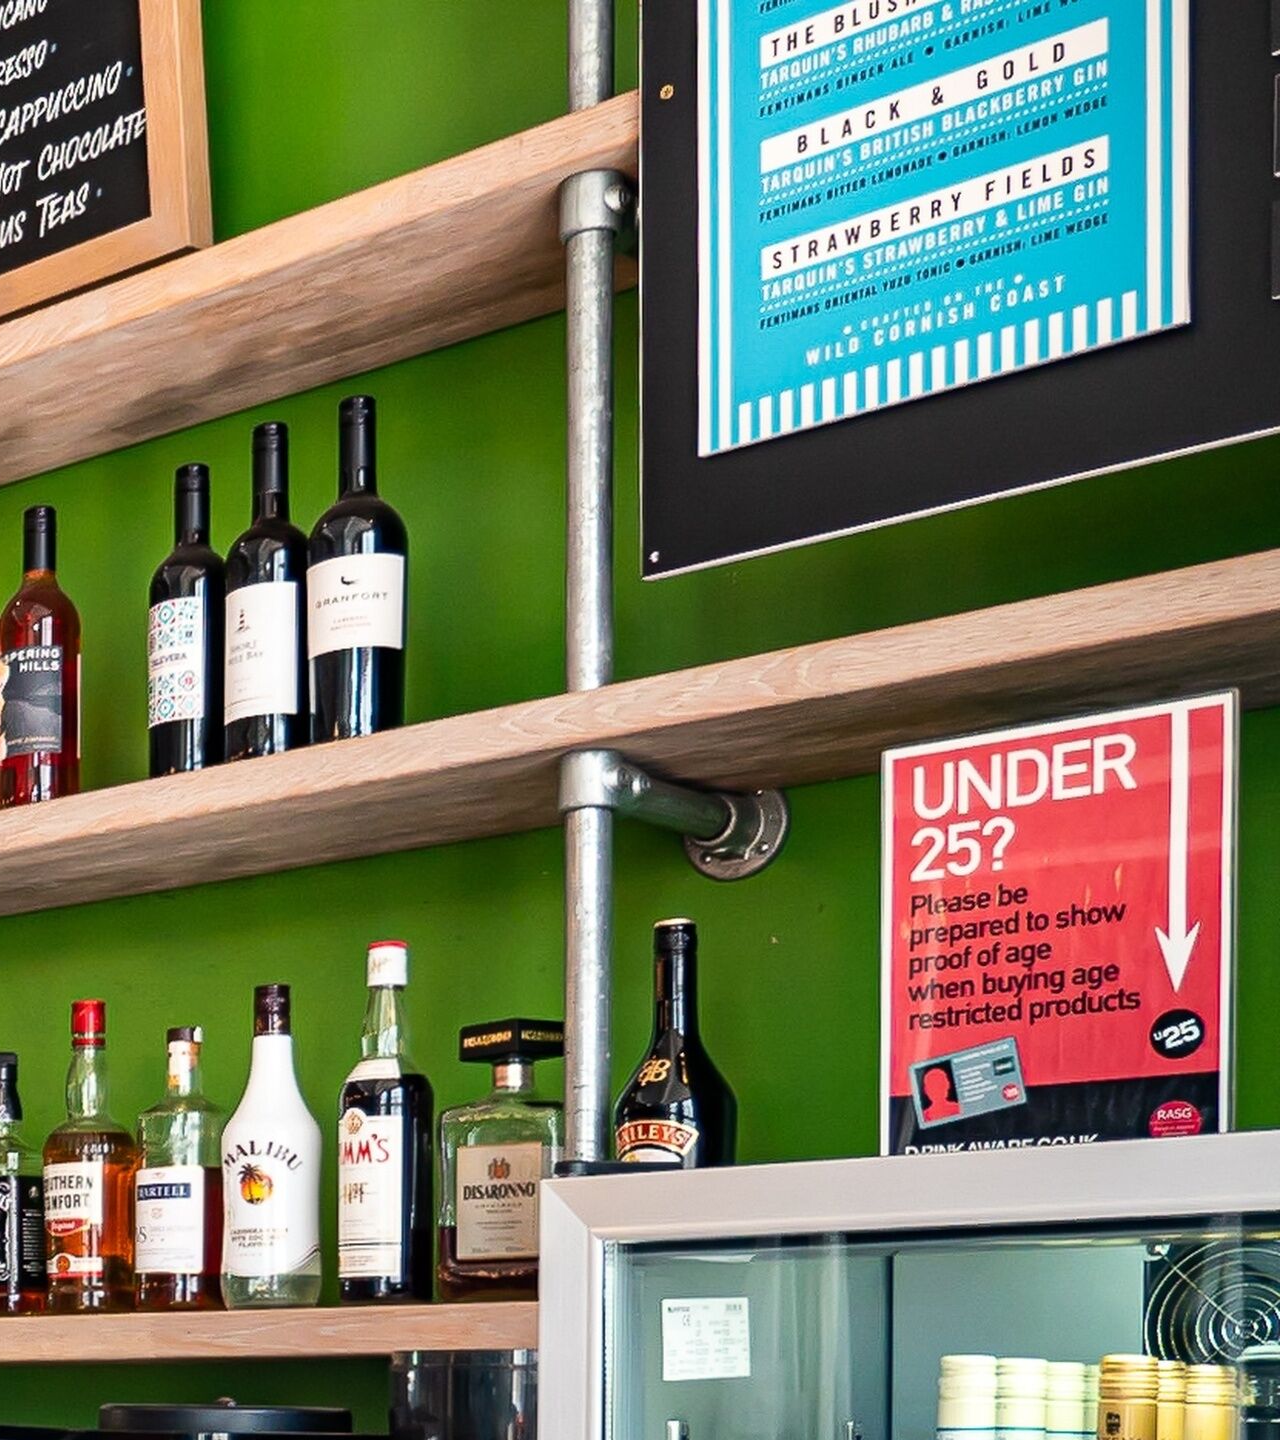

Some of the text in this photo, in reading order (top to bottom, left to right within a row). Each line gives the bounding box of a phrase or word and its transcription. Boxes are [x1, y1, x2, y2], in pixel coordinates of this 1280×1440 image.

[760, 3, 954, 89] TARQUIN'S RHUBARB &
[772, 24, 814, 57] THE
[760, 86, 830, 117] FENTIMANS
[889, 51, 914, 70] ALE
[796, 42, 1067, 154] BLACK & GOLD
[38, 107, 147, 181] CHOCOLATE
[761, 58, 1108, 195] TARQUIN'S BRITISH BLACKBERRY GIN
[760, 193, 821, 223] FENTIMANS
[870, 154, 933, 187] LEMONADE
[1016, 112, 1059, 136] LEMON
[1064, 95, 1108, 119] WEDGE
[37, 183, 90, 238] TEAS
[773, 148, 1096, 270] STRAWBERRY FIELDS
[761, 176, 1109, 301] TARQUIN'S STRAWBERRY & LIME GIN
[760, 301, 820, 330] FENTIMANS
[825, 284, 877, 309] ORIENTAL
[916, 262, 950, 284] TONIC
[1030, 228, 1060, 248] LIME
[1066, 213, 1109, 237] WEDGE
[805, 274, 1066, 366] WILD CORNISH COAST
[860, 300, 931, 330] CRAFTED
[974, 276, 1004, 297] THE
[5, 648, 60, 663] PERING
[19, 660, 60, 672] HILLS
[912, 732, 1137, 821] UNDER
[909, 816, 1016, 883] 25?
[909, 903, 1126, 948] prepared to show
[910, 884, 1028, 918] Please be
[909, 940, 1052, 979] proof of age
[909, 962, 1120, 1003] when buying age
[909, 989, 1141, 1031] restricted products
[1157, 1107, 1193, 1121] RASG
[225, 1140, 303, 1171] MALIBU
[341, 1133, 390, 1165] MM'S
[463, 1182, 536, 1202] DISARONNO
